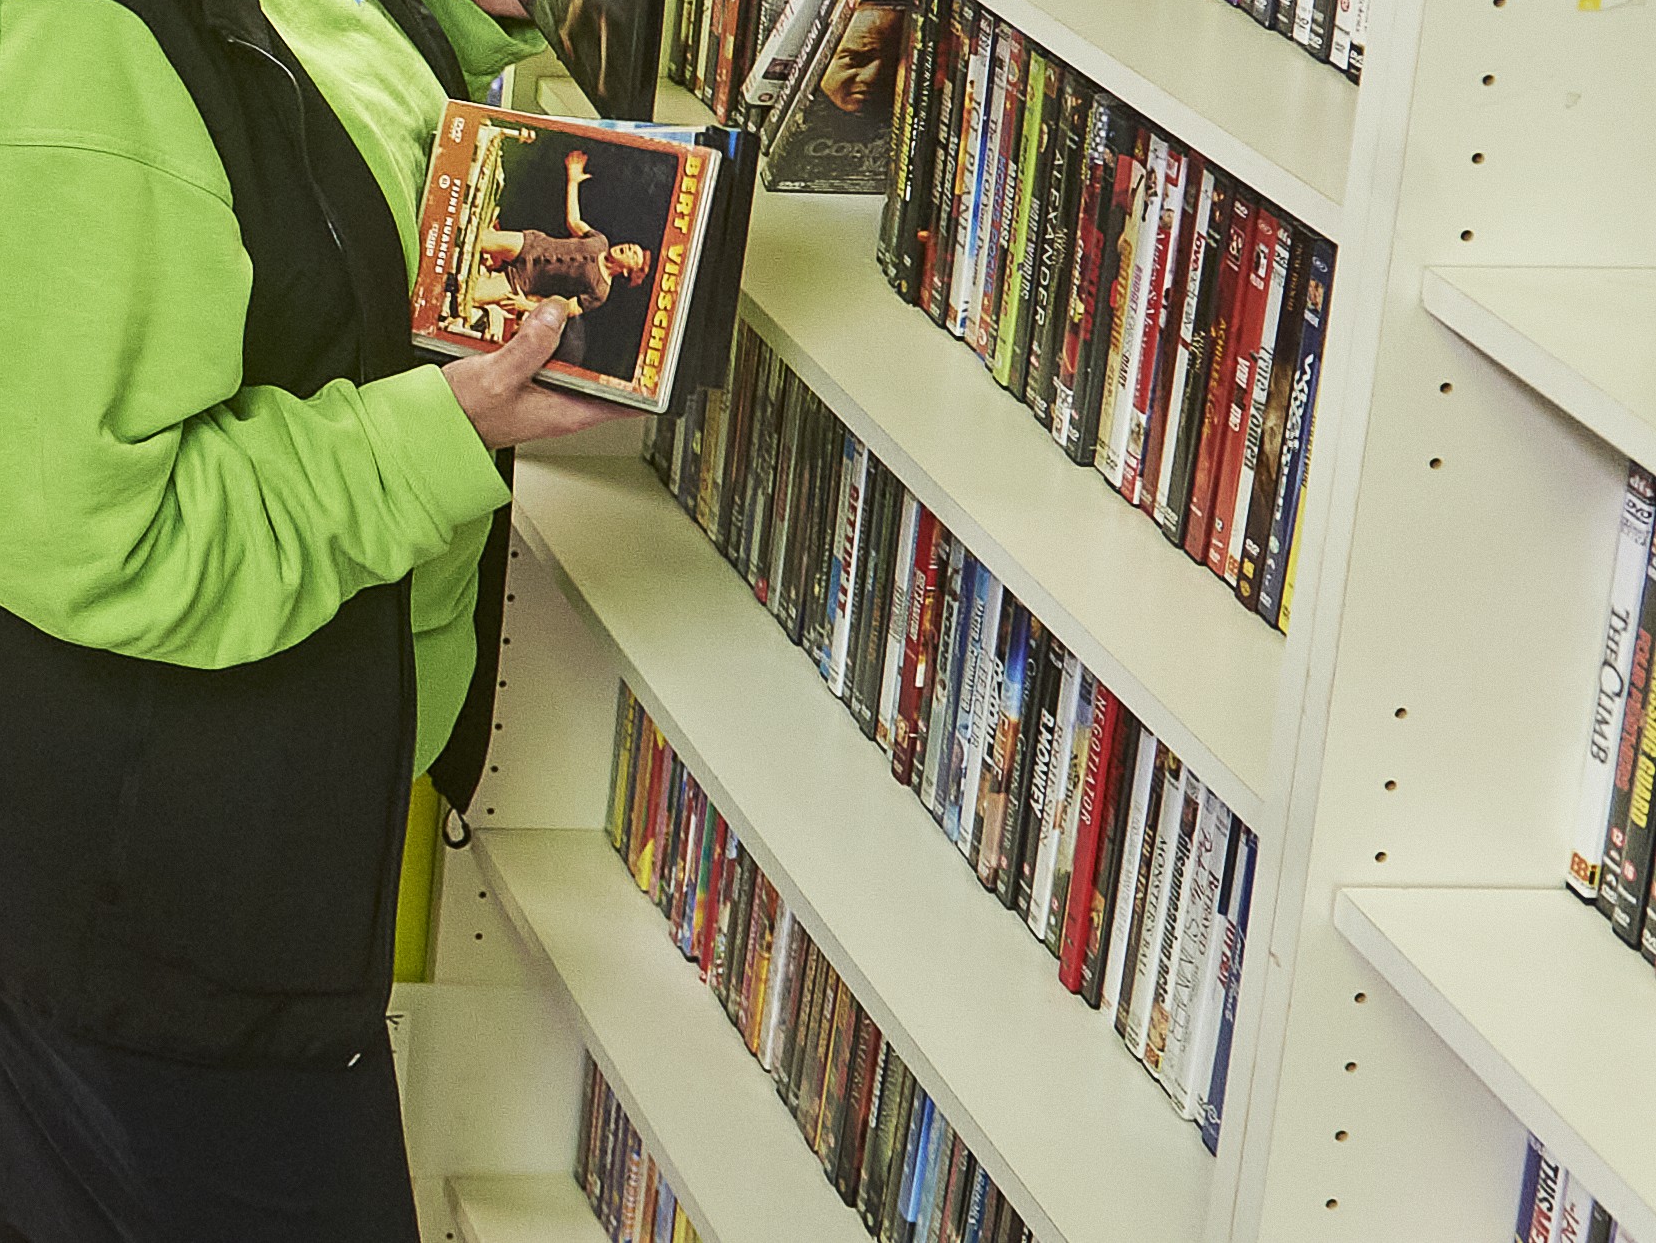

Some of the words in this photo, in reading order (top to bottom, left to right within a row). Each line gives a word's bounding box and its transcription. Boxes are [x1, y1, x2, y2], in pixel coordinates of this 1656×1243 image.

[768, 18, 821, 124] UNDERGROUND
[917, 39, 935, 133] SUPERNATURAL
[969, 97, 983, 141] ICE
[672, 155, 703, 234] BERT
[955, 149, 977, 253] PLANET
[990, 154, 1007, 225] HOCUS
[998, 162, 1017, 249] MADHOUSE
[983, 227, 998, 294] POCUS
[1019, 238, 1037, 300] WORLDS
[1034, 148, 1065, 327] ALEXANDER
[640, 245, 683, 388] VISSCHER
[1117, 353, 1132, 390] DIARY
[1253, 347, 1274, 389] True
[1243, 398, 1266, 471] Women
[839, 484, 861, 580] GETTIN'
[837, 586, 849, 620] IT
[1604, 604, 1632, 662] THE
[1589, 660, 1628, 766] CLIMB
[1027, 708, 1055, 820] B.MONKEY
[1079, 695, 1108, 825] NEGOTIATOR
[1630, 761, 1654, 829] GUARD
[1144, 835, 1168, 935] MONSTER'S
[1160, 833, 1192, 961] disappearing
[1138, 938, 1152, 978] BALL
[1156, 962, 1173, 1006] acts
[1536, 1156, 1560, 1213] THIS
